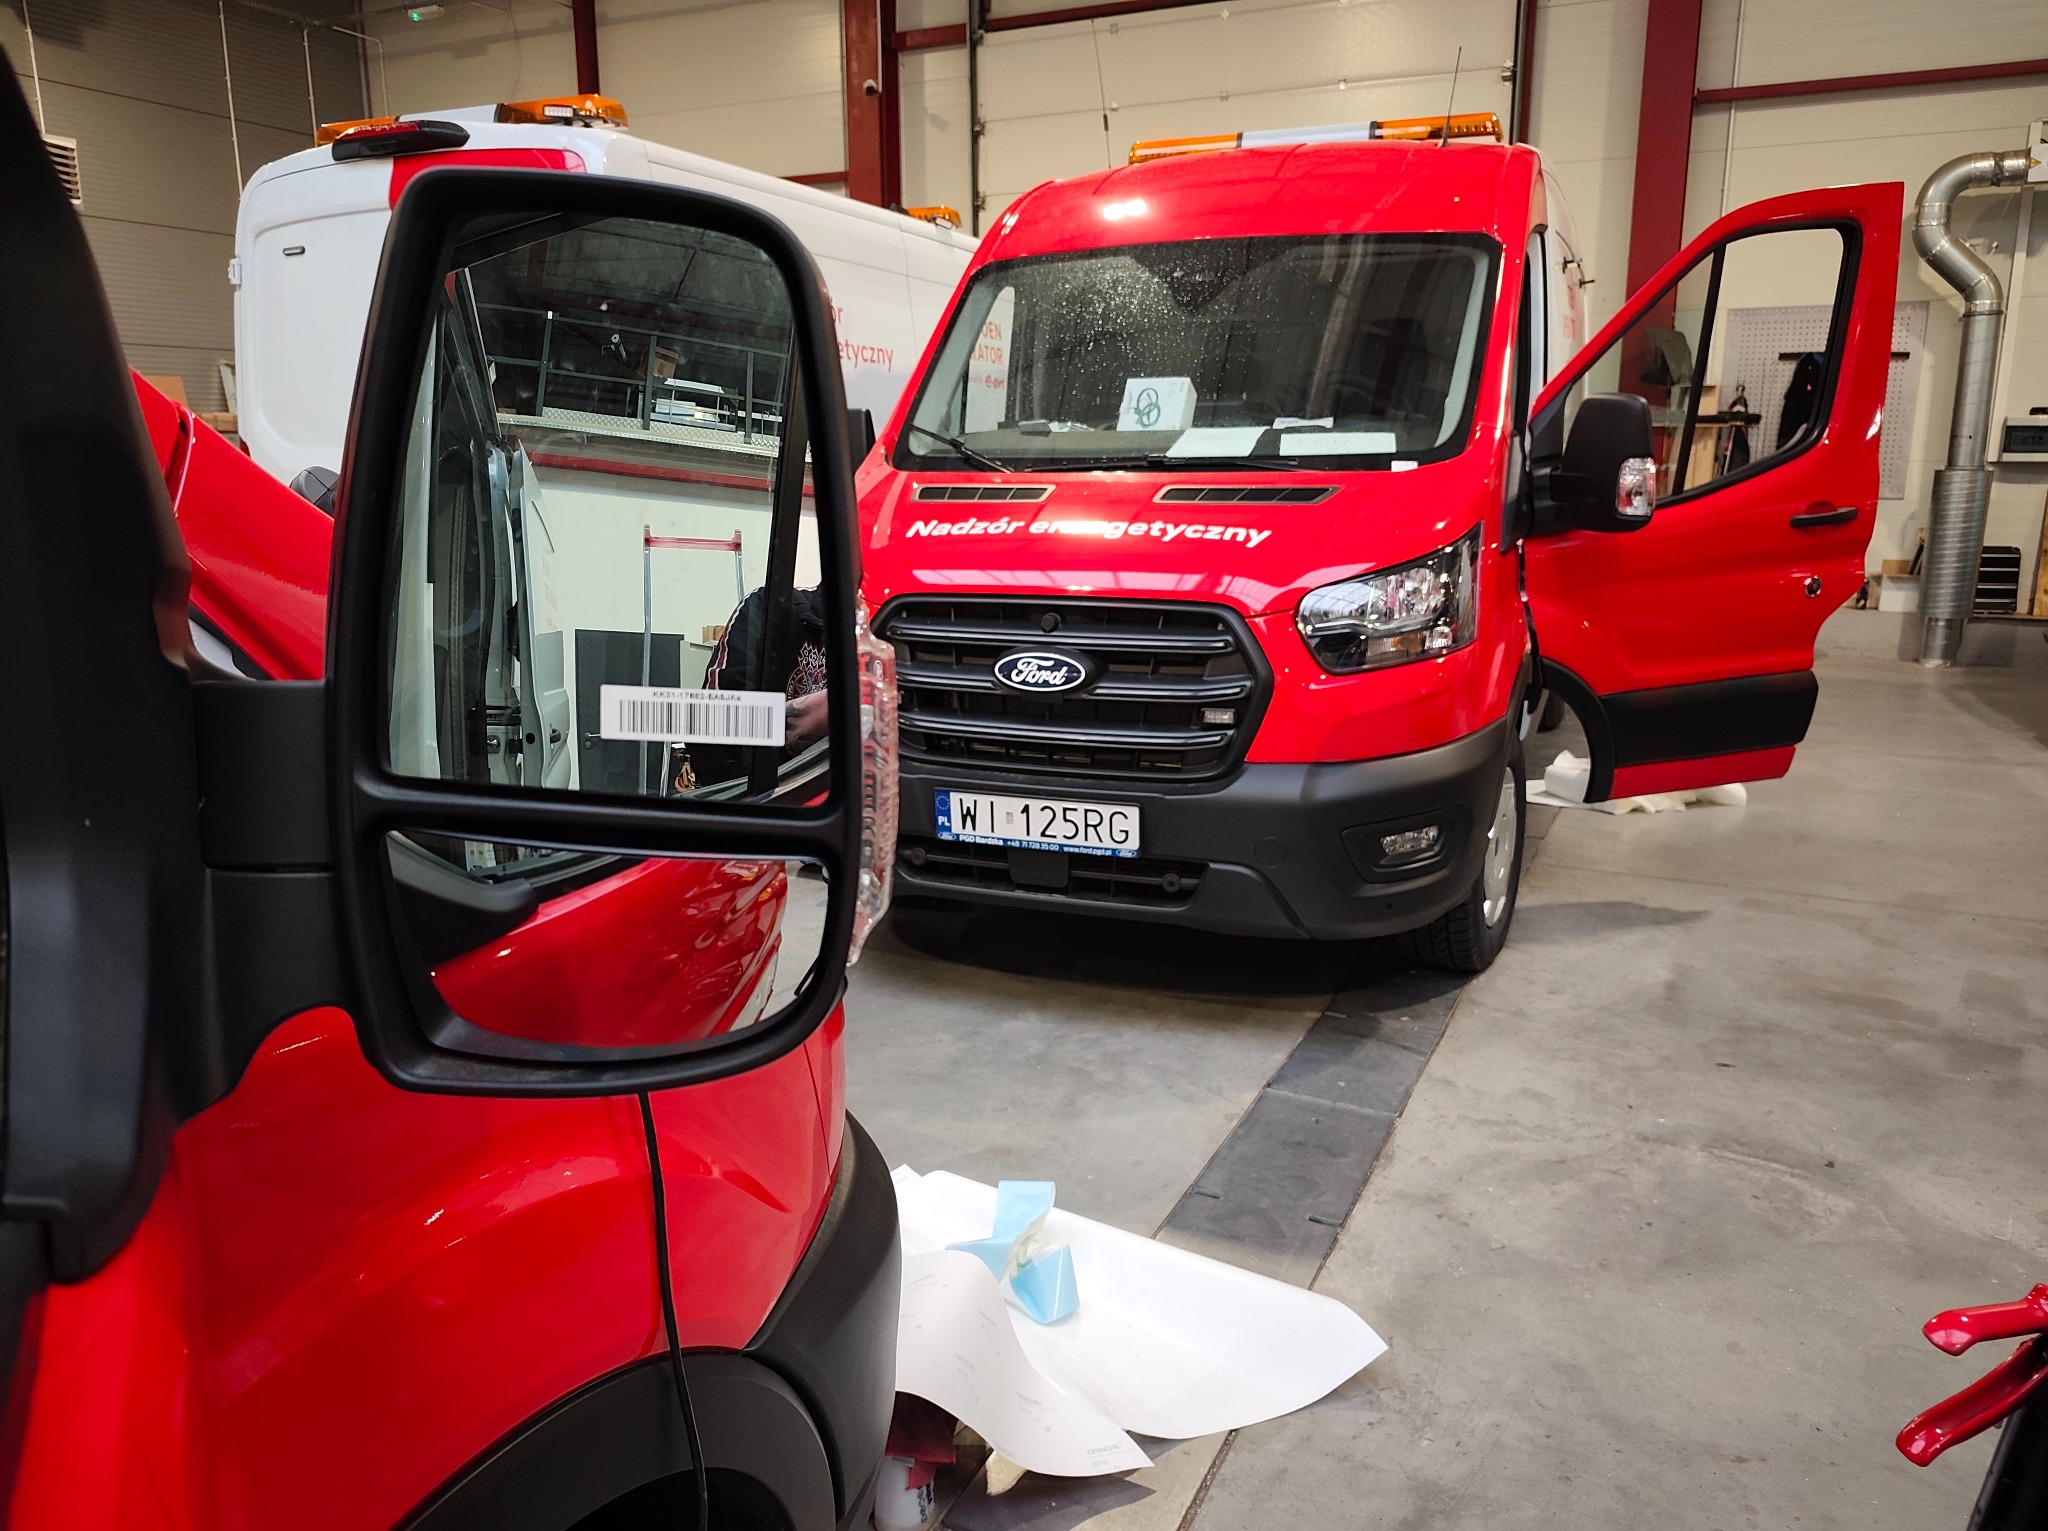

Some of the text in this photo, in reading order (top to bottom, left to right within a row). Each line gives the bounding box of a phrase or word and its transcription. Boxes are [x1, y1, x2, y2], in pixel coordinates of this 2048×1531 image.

[905, 517, 1273, 548] Nadzór engetyczny
[1010, 657, 1069, 686] Ford
[938, 816, 950, 827] PL
[959, 797, 1130, 845] WI 125RG
[959, 834, 975, 842] PGD
[975, 836, 1004, 846] Bardzka
[1007, 839, 1020, 848] +48
